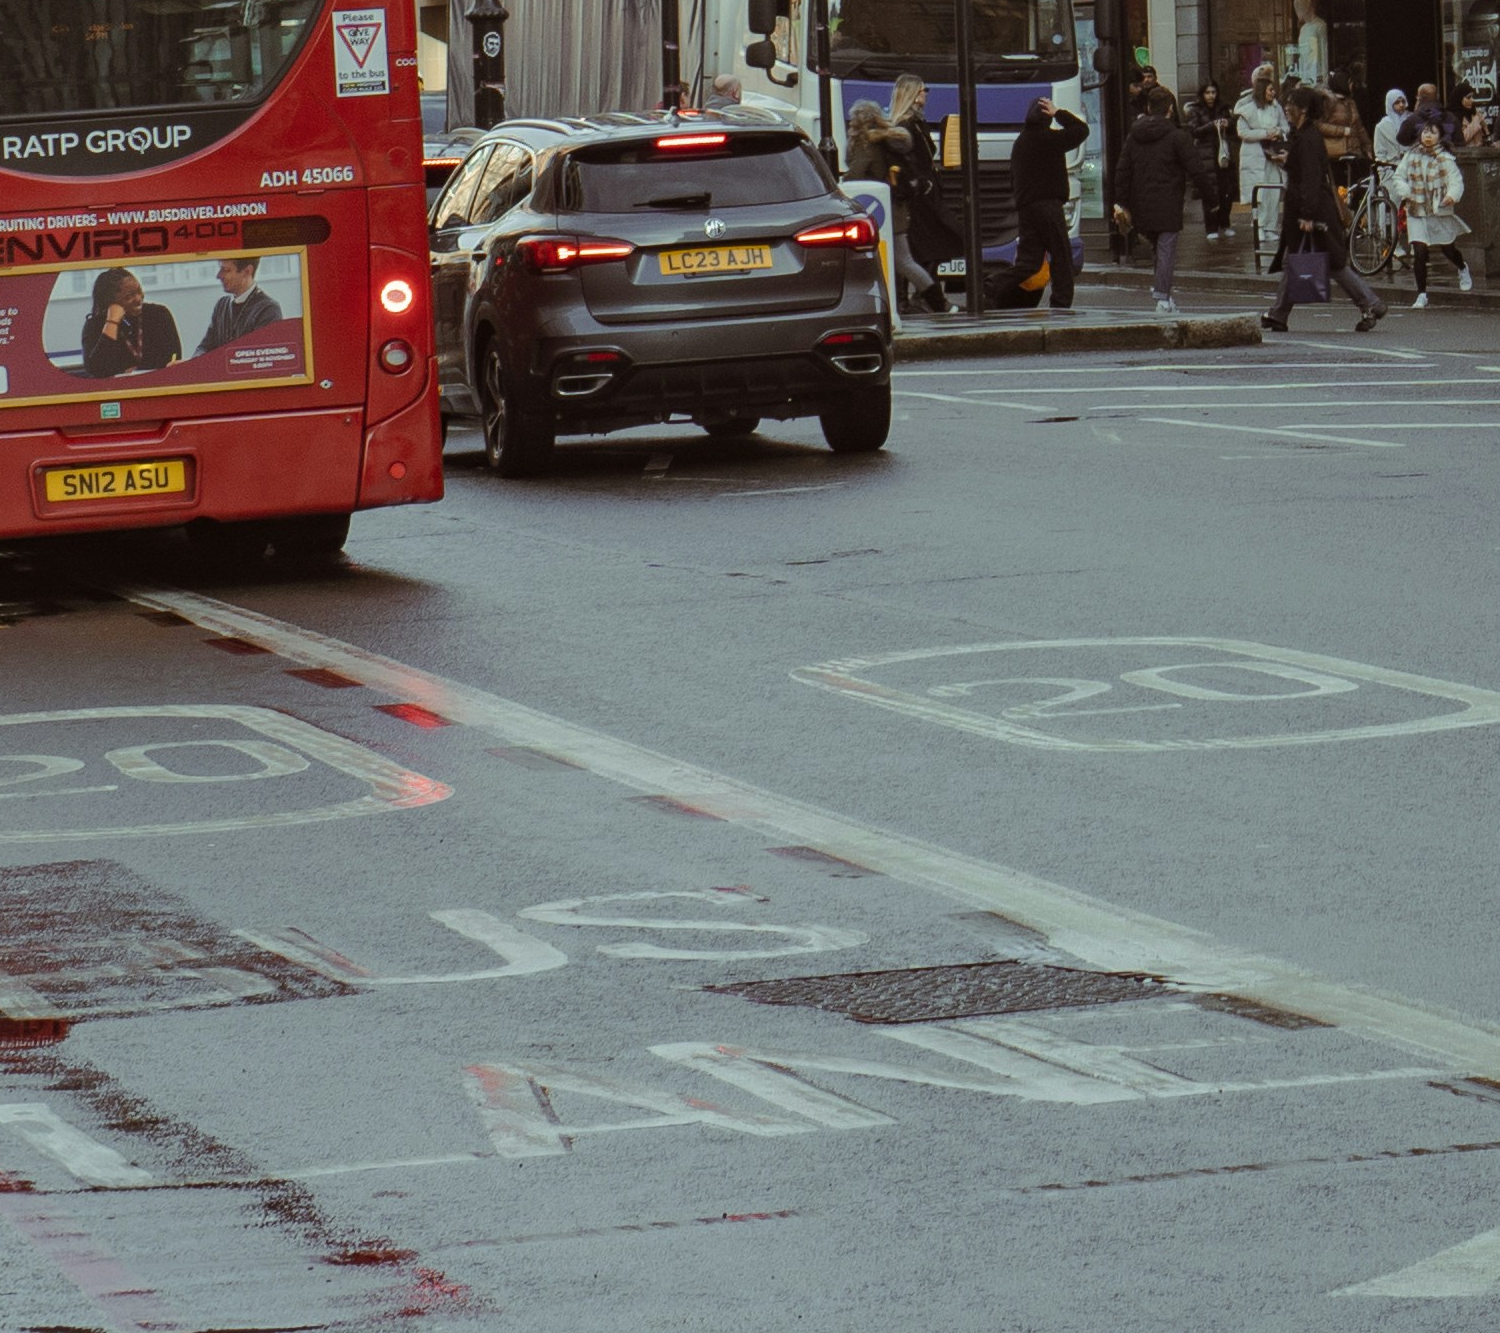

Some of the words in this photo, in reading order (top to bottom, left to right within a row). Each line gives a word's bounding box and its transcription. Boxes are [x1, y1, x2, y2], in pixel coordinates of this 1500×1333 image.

[342, 13, 375, 22] Please
[348, 27, 369, 37] GIVE
[351, 37, 370, 45] WAY
[338, 71, 349, 80] to
[351, 70, 367, 79] the
[369, 69, 386, 78] bus
[3, 133, 79, 159] RATP
[86, 125, 192, 154] GROUP
[260, 170, 297, 188] ADH
[302, 166, 354, 184] 45066
[47, 214, 97, 230] DRIVERS
[107, 202, 267, 225] WWW.BUSDRIVER.LONDON
[173, 221, 238, 240] 400
[668, 251, 720, 271] LC23
[727, 248, 764, 266] AJH
[235, 350, 255, 358] OPEN
[63, 471, 116, 496] SN12
[124, 467, 169, 491] ASU
[925, 663, 1359, 719] 20
